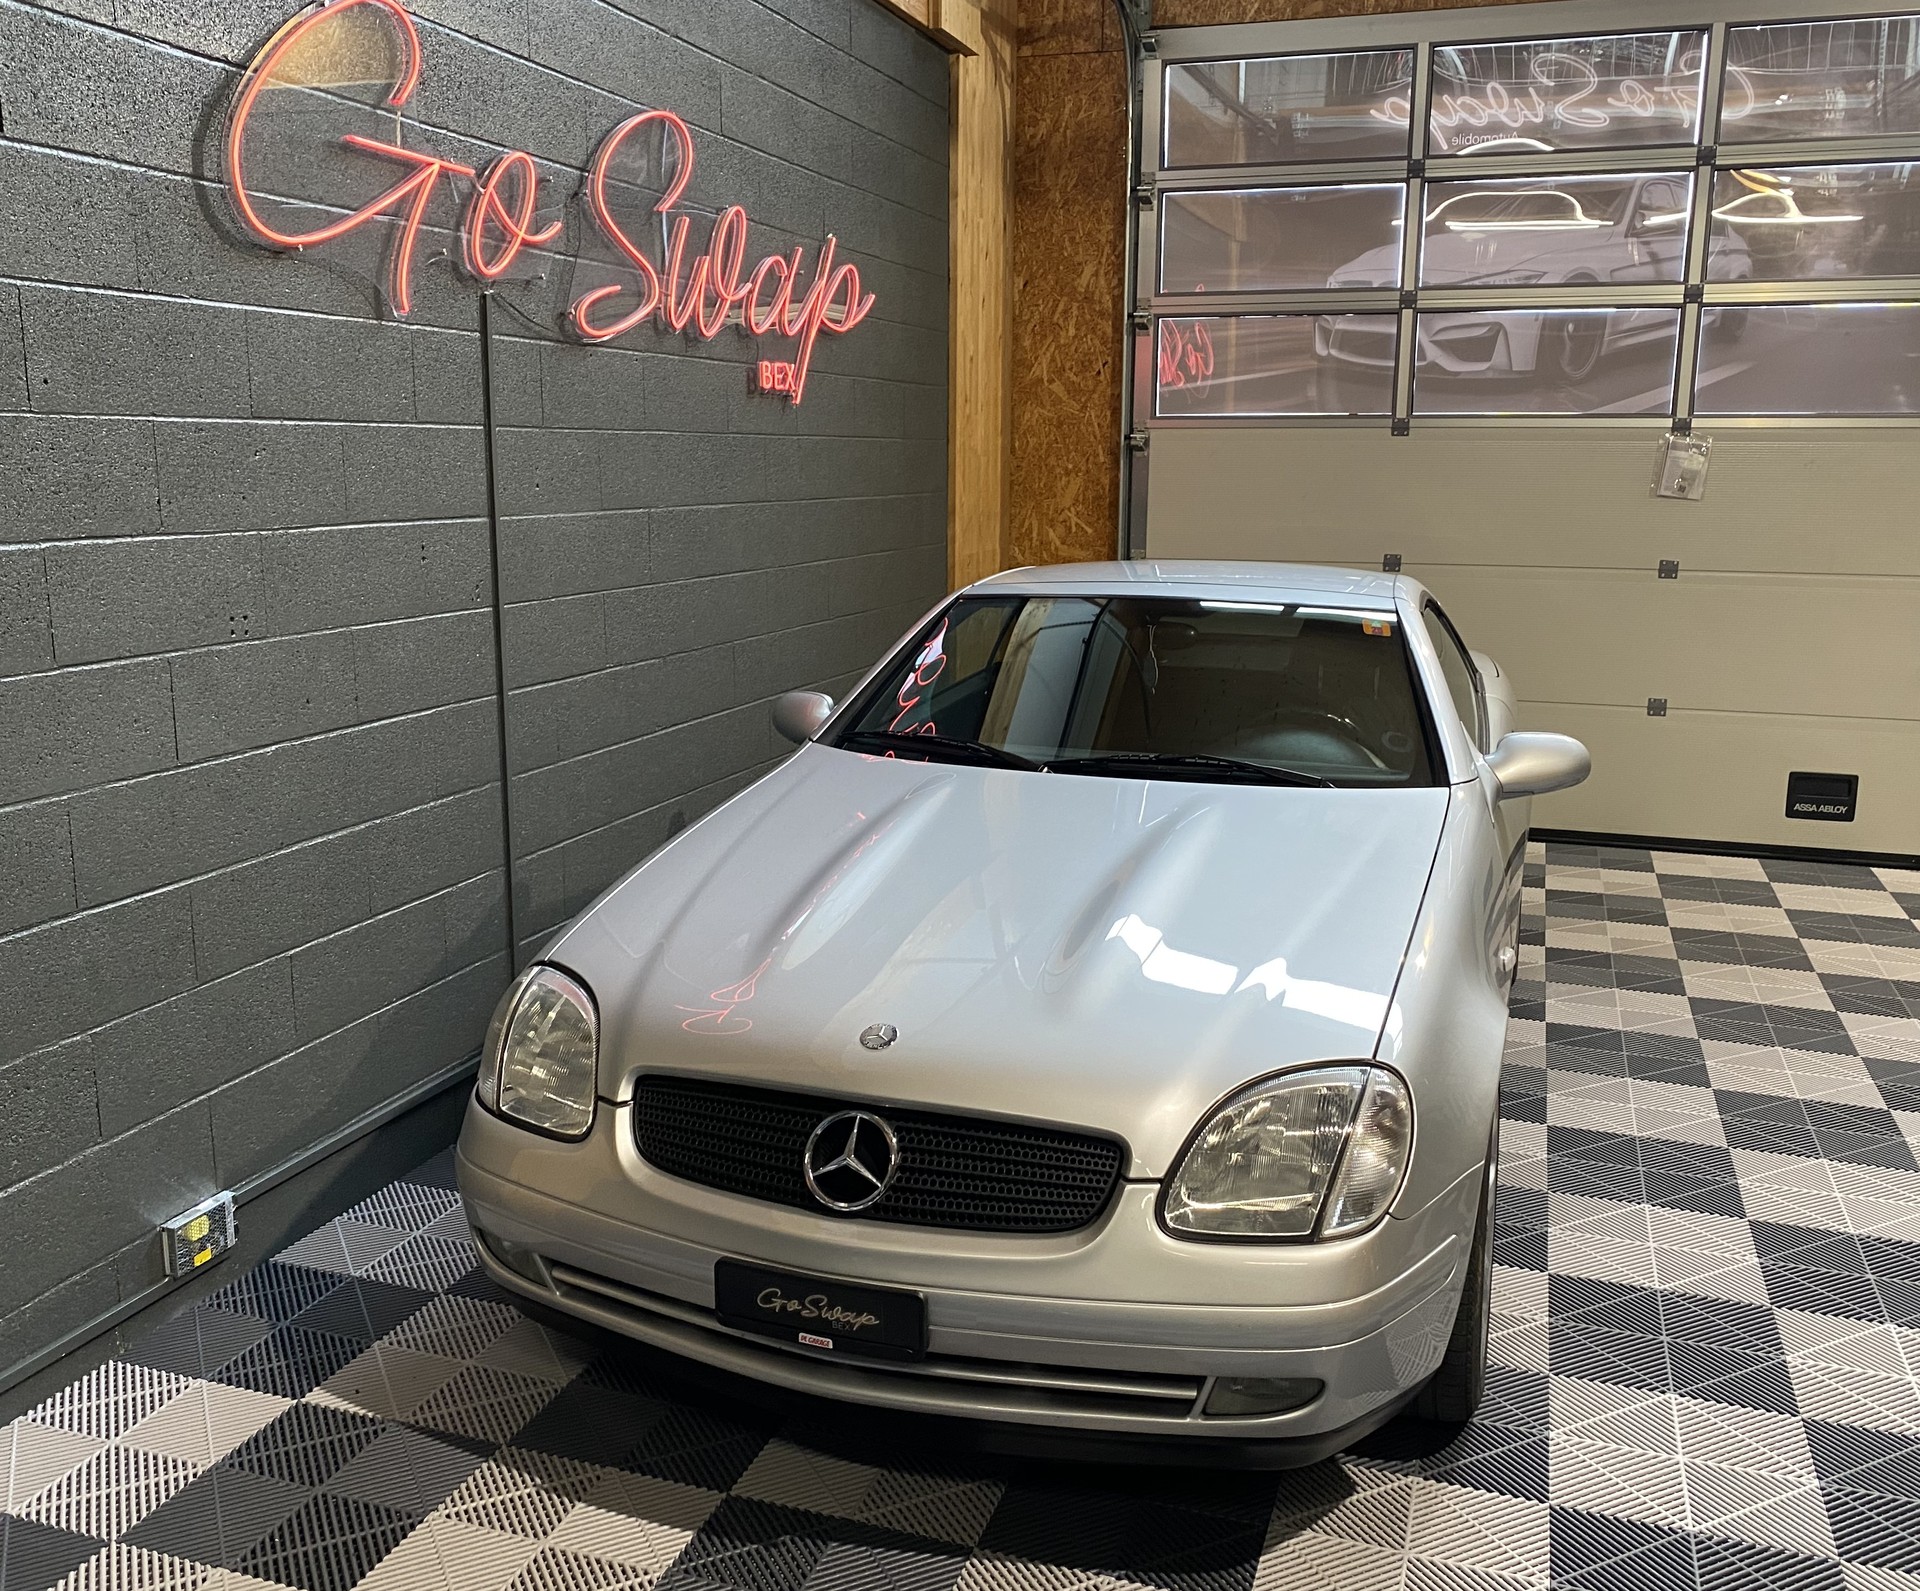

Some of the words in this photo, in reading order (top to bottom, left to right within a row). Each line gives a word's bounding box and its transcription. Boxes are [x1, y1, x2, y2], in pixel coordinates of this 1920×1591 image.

[224, 0, 563, 314] Go
[571, 109, 876, 405] Swap
[759, 360, 796, 391] BEX
[1793, 803, 1817, 812] ASSA
[1818, 805, 1848, 814] ABLOY
[832, 1321, 851, 1331] BEX
